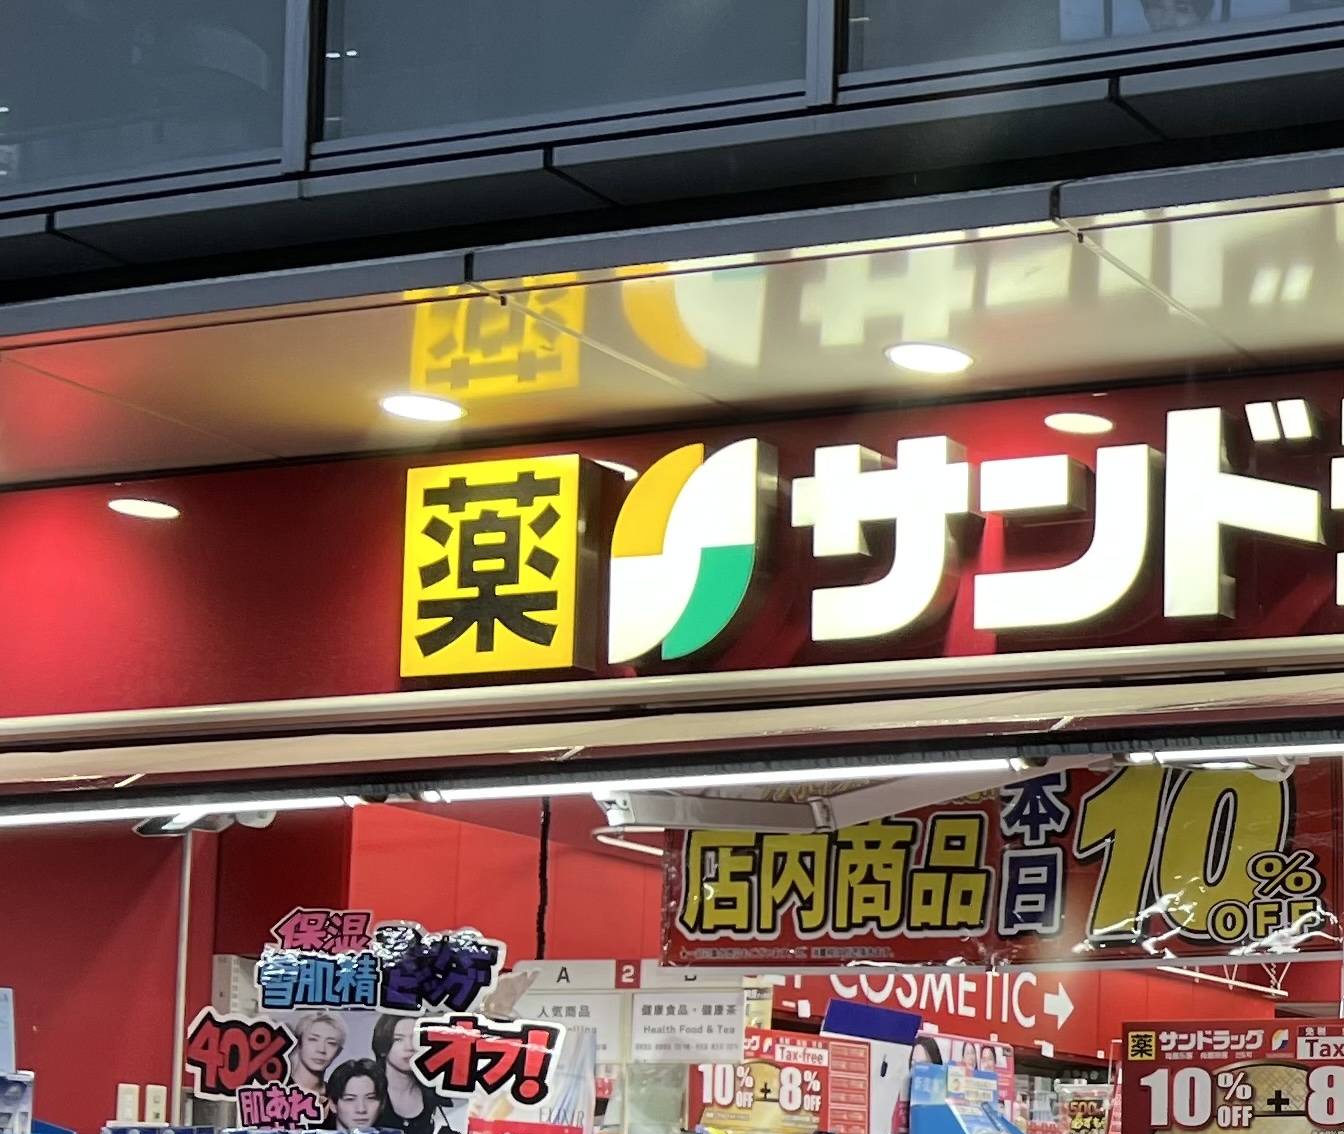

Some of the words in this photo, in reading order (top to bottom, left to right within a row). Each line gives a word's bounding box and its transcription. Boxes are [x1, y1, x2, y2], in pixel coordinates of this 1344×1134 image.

[418, 471, 560, 658] 薬
[1001, 770, 1068, 935] 本日
[682, 822, 990, 935] 店内商品
[1209, 900, 1322, 942] OFF
[260, 953, 378, 1005] 雪肌精
[557, 967, 570, 983] A
[621, 965, 634, 983] 2
[538, 1005, 591, 1018] 人気商品
[643, 1025, 677, 1035] Health
[680, 1025, 703, 1035] Food
[718, 1026, 736, 1035] Tea
[1130, 1034, 1154, 1057] 薬
[1159, 1030, 1264, 1050] サンドラッグ
[187, 1018, 288, 1090] 40%
[780, 1046, 824, 1064] Tax-free
[736, 1091, 753, 1108] OFF
[1217, 1106, 1252, 1128] OFF
